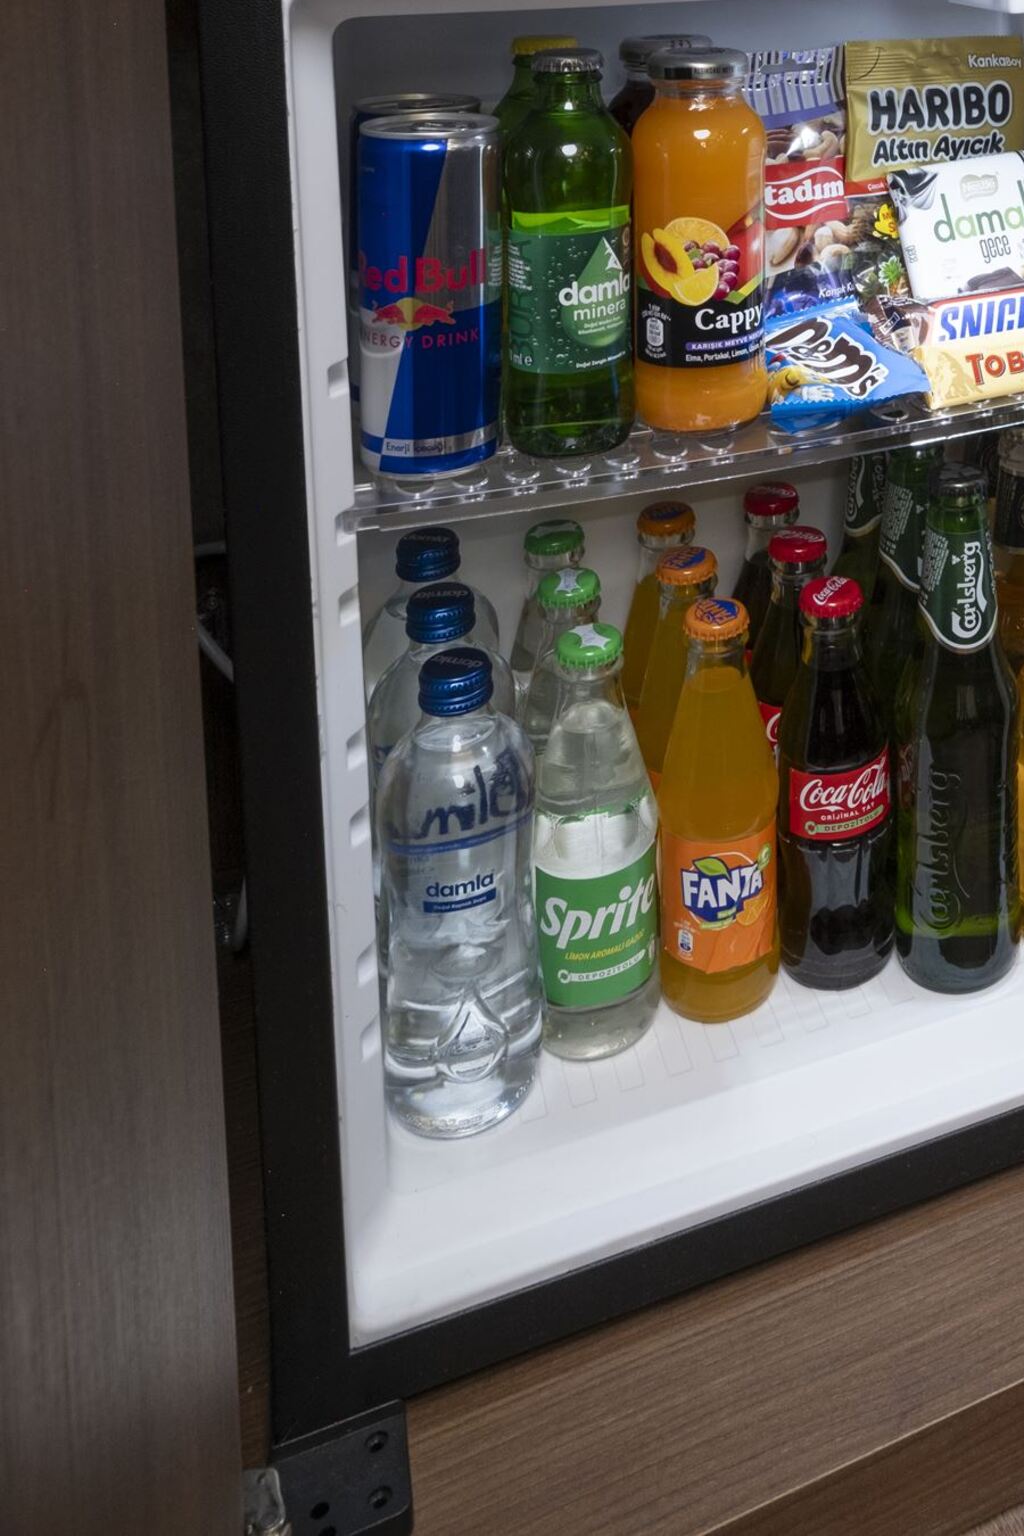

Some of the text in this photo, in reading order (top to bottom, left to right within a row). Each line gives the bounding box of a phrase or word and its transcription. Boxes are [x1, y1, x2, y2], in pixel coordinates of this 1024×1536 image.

[869, 81, 1011, 133] HARIBO
[873, 132, 1003, 166] Altın Ayıcık
[764, 178, 844, 206] tadım
[979, 235, 1011, 264] gece
[415, 248, 487, 294] Bull
[559, 272, 630, 306] damla
[573, 298, 626, 321] minera
[695, 304, 763, 334] Cappy
[422, 327, 480, 348] DRINK
[951, 541, 988, 639] Carlsberg
[800, 756, 886, 812] Coca-Cola
[426, 873, 494, 897] damla
[682, 863, 763, 909] FANTA
[540, 873, 655, 950] Sprite
